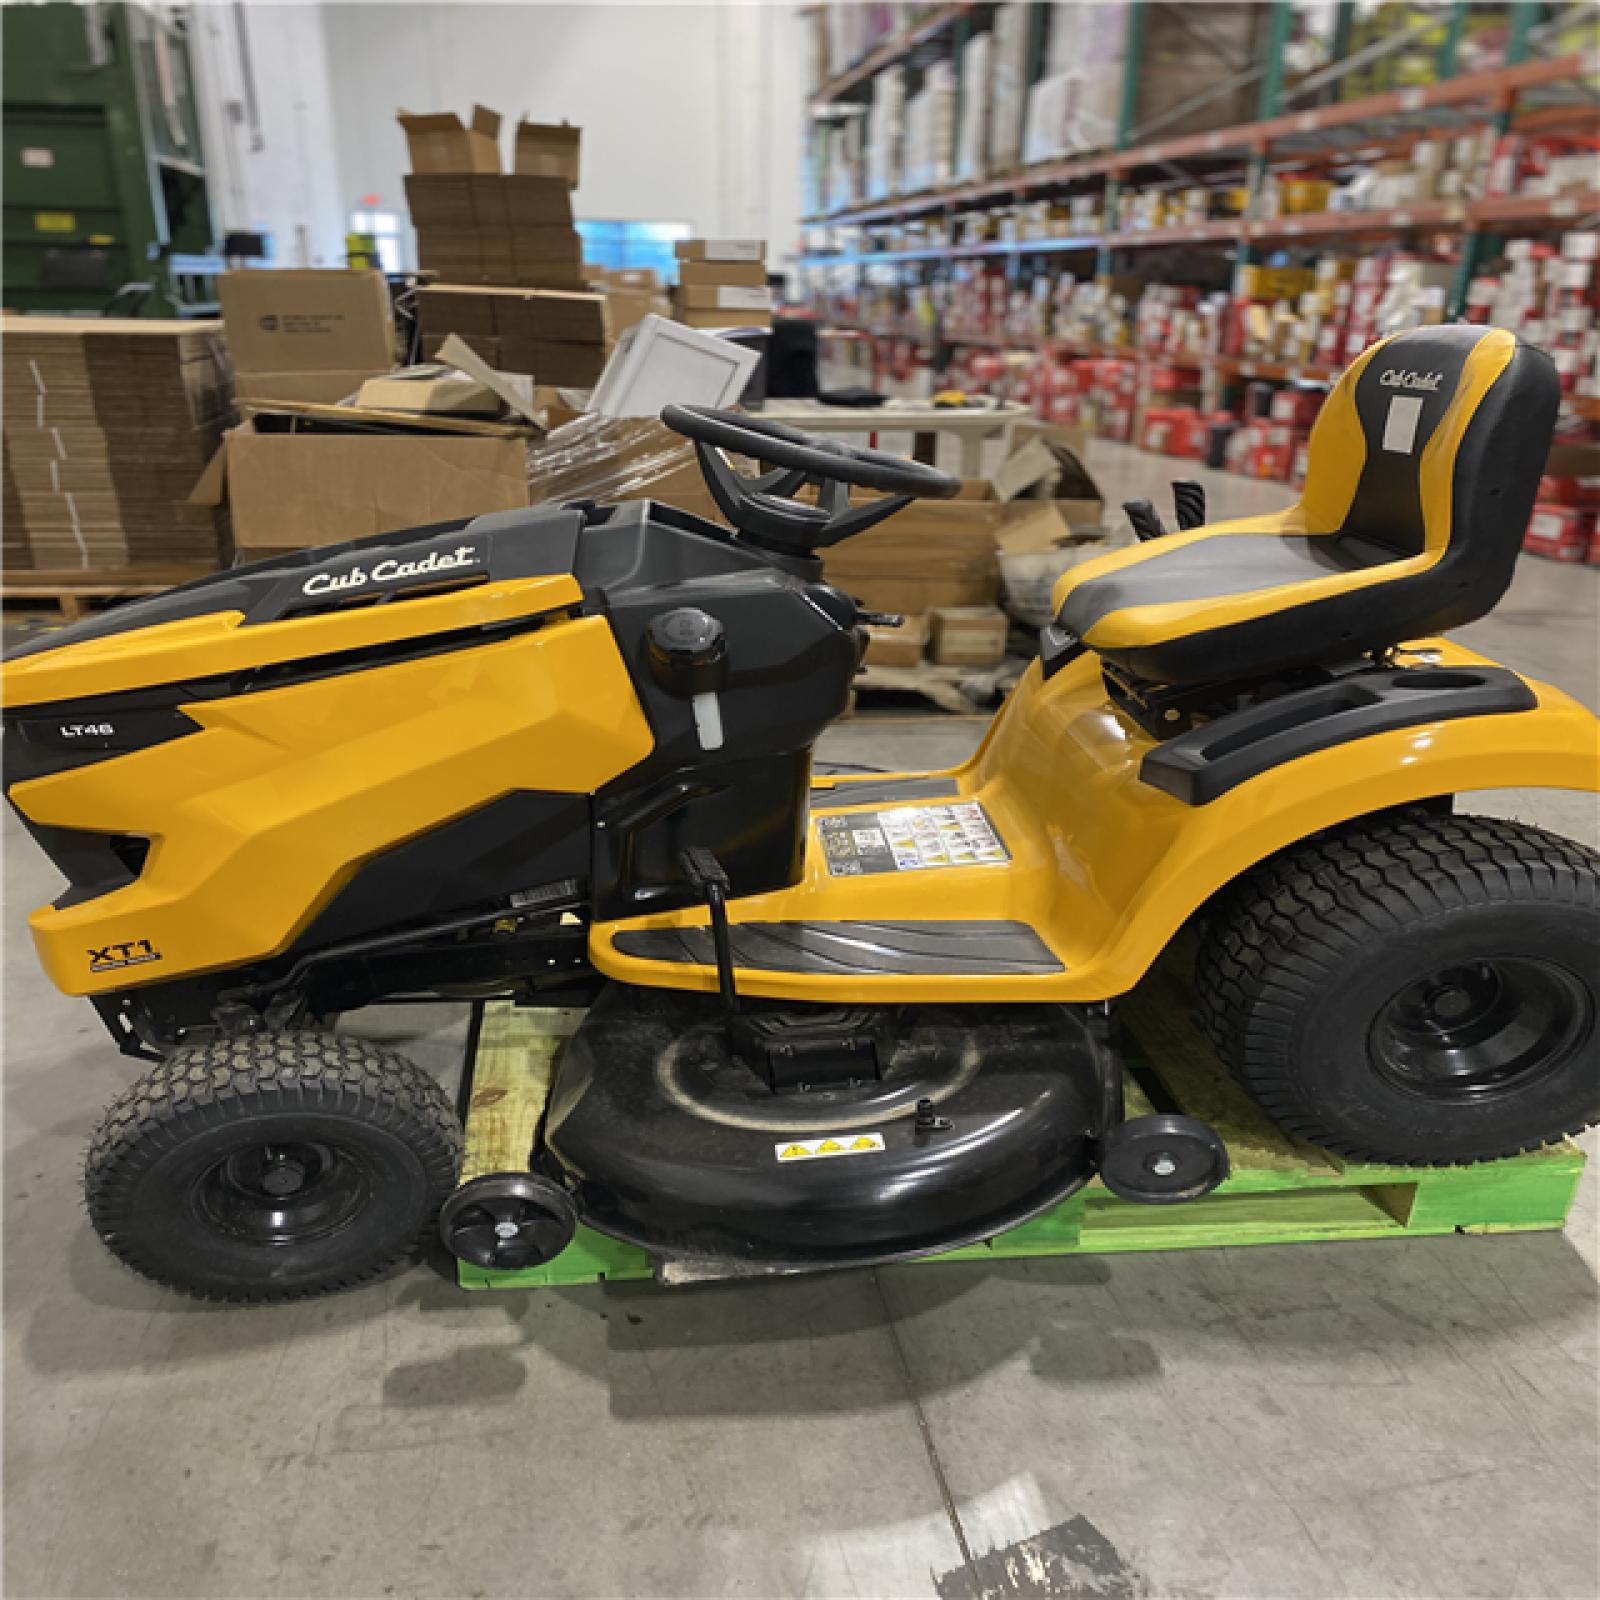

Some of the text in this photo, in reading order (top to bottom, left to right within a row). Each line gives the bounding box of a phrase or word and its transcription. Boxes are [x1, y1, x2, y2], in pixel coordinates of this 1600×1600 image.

[302, 546, 475, 595] Cub Cadet
[87, 940, 154, 965] XT1
